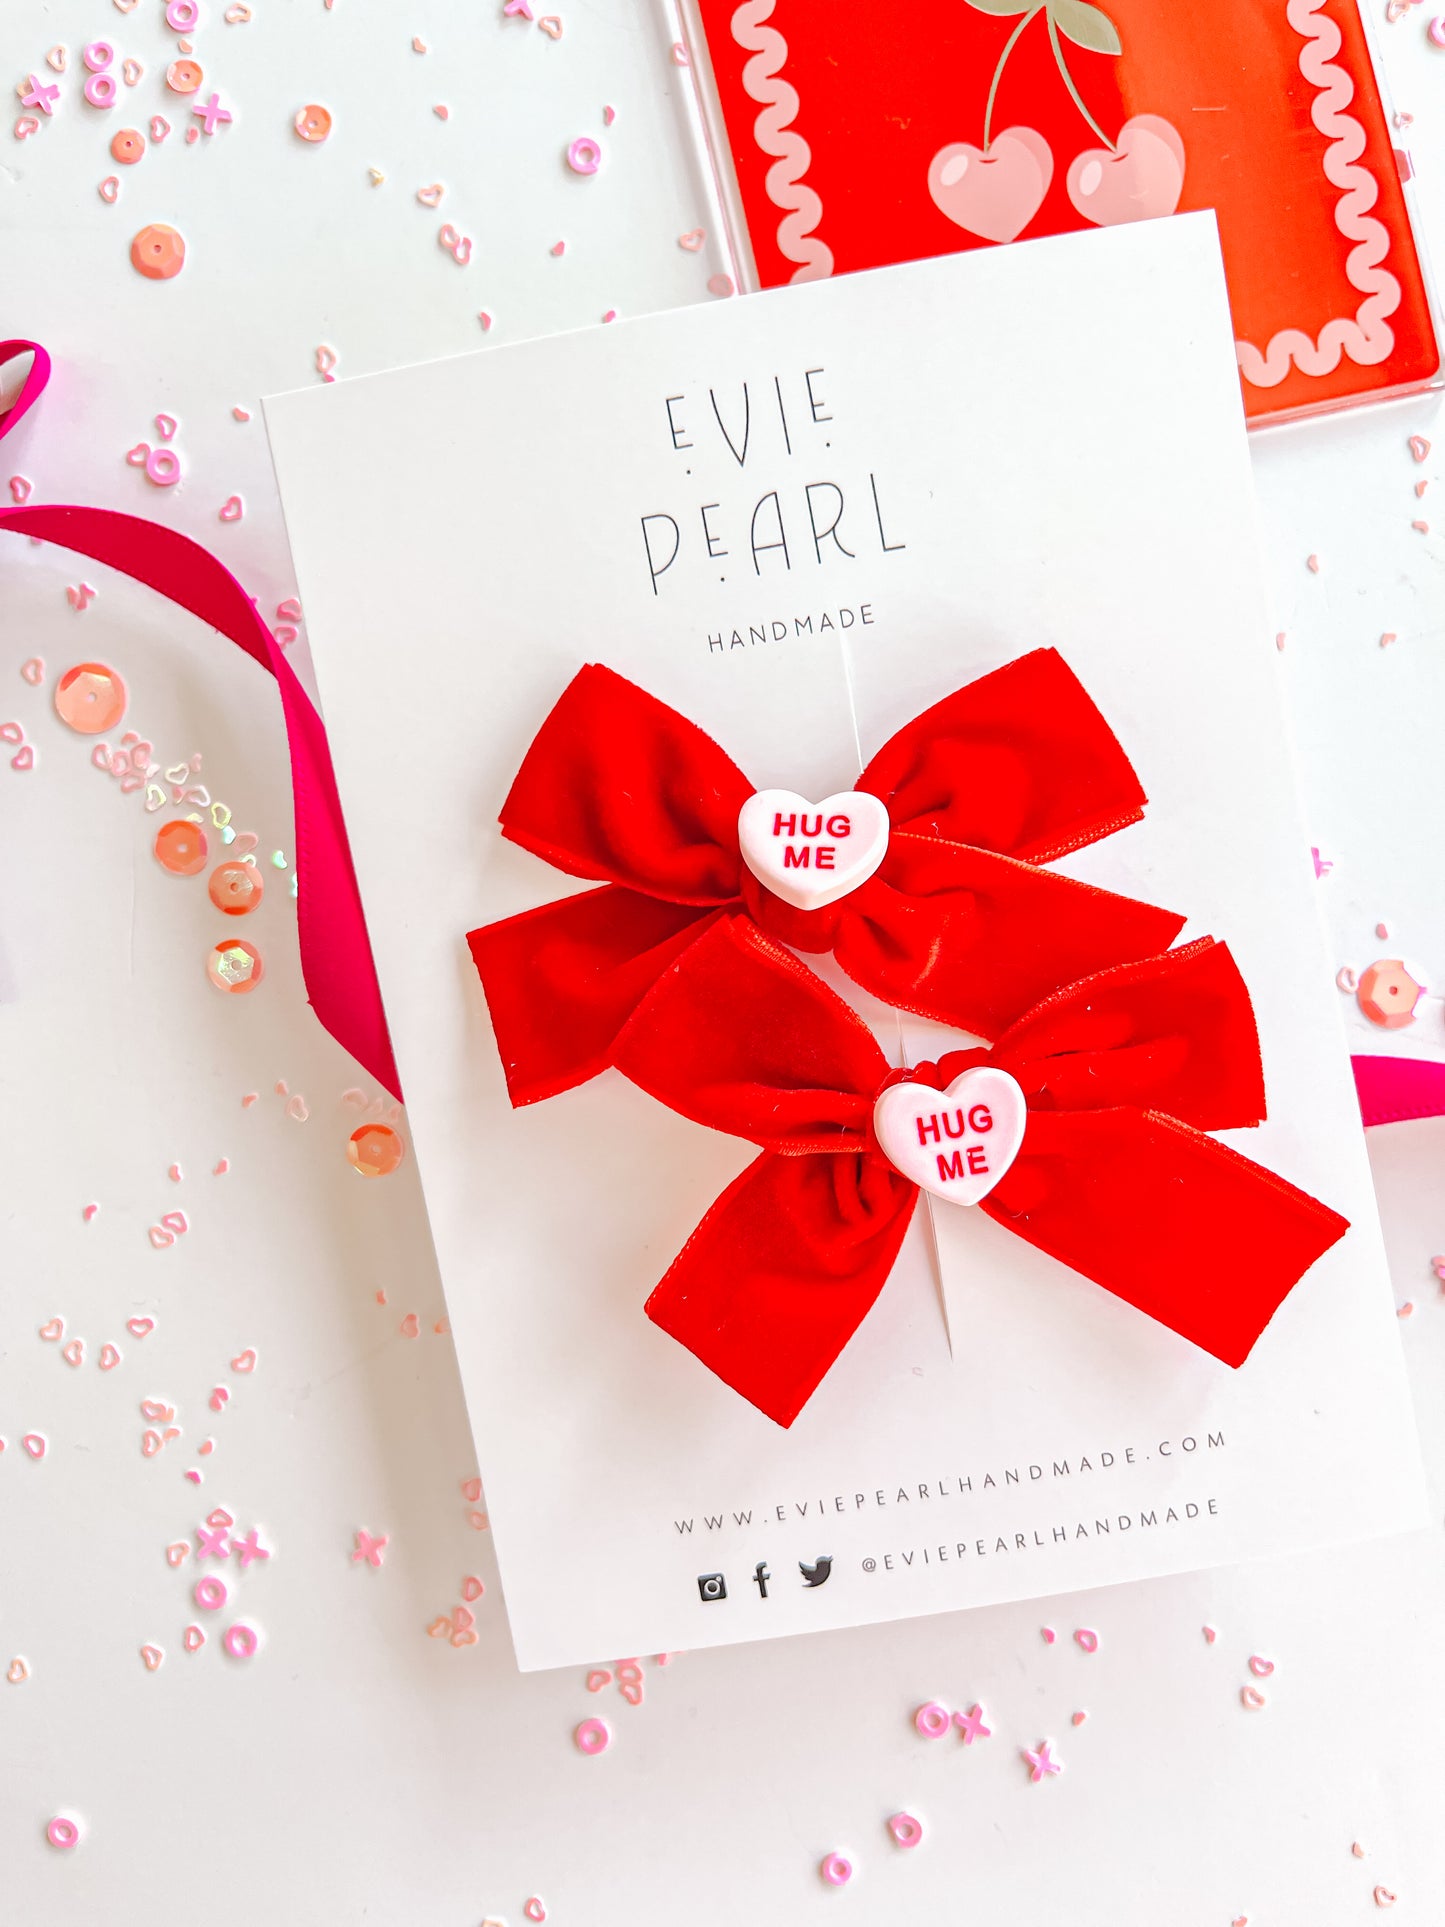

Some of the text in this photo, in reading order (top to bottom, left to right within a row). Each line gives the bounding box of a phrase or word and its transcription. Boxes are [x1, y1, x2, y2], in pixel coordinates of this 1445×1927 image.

[666, 368, 833, 474] EVIE
[641, 473, 906, 595] PEARL
[707, 604, 875, 653] HANDMADE
[773, 812, 851, 839] HUG
[784, 845, 837, 870] ME
[916, 1104, 994, 1146] HUG
[936, 1146, 990, 1182] ME
[675, 1431, 1226, 1535] WWW.EVIEPEARLHANDMADE.COM
[862, 1498, 1219, 1573] @EVIEPEARLHANDMADE
